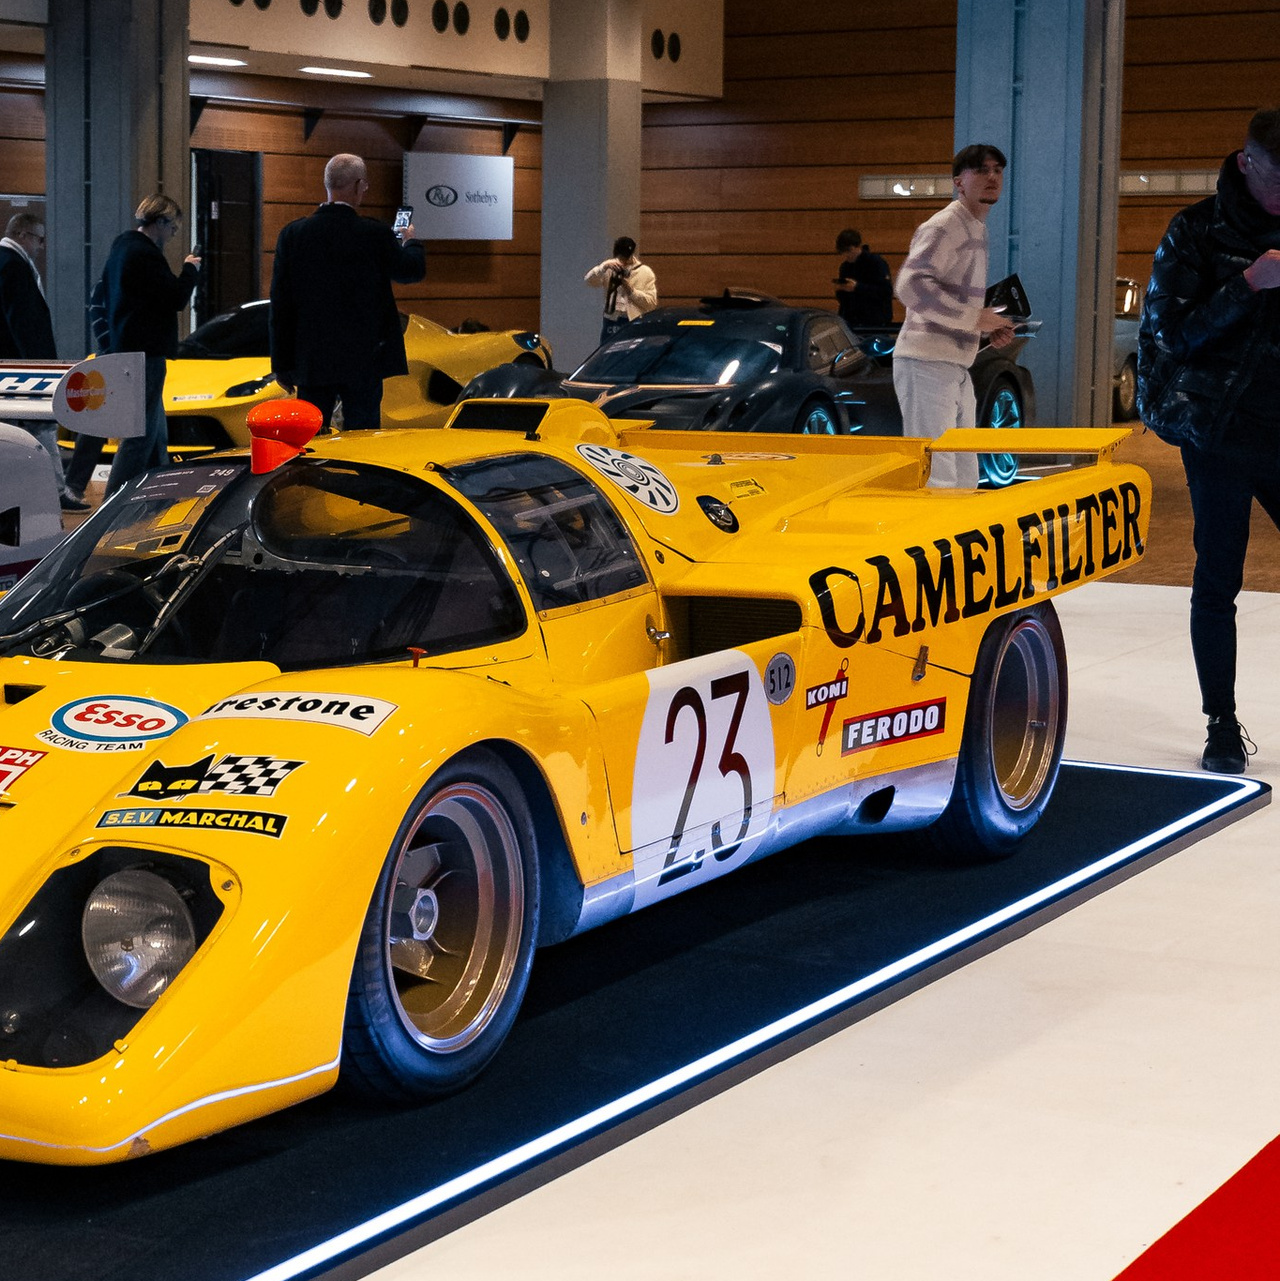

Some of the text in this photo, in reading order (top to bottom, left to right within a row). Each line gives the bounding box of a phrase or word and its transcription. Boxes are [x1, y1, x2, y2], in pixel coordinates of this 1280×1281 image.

[464, 190, 498, 207] Sotheby's
[767, 664, 793, 693] 512
[807, 680, 848, 706] KONI
[847, 705, 940, 749] FERODO
[38, 729, 144, 752] RACING TEAM
[657, 670, 753, 887] 23
[105, 810, 278, 833] S.E.V. MARCHAL
